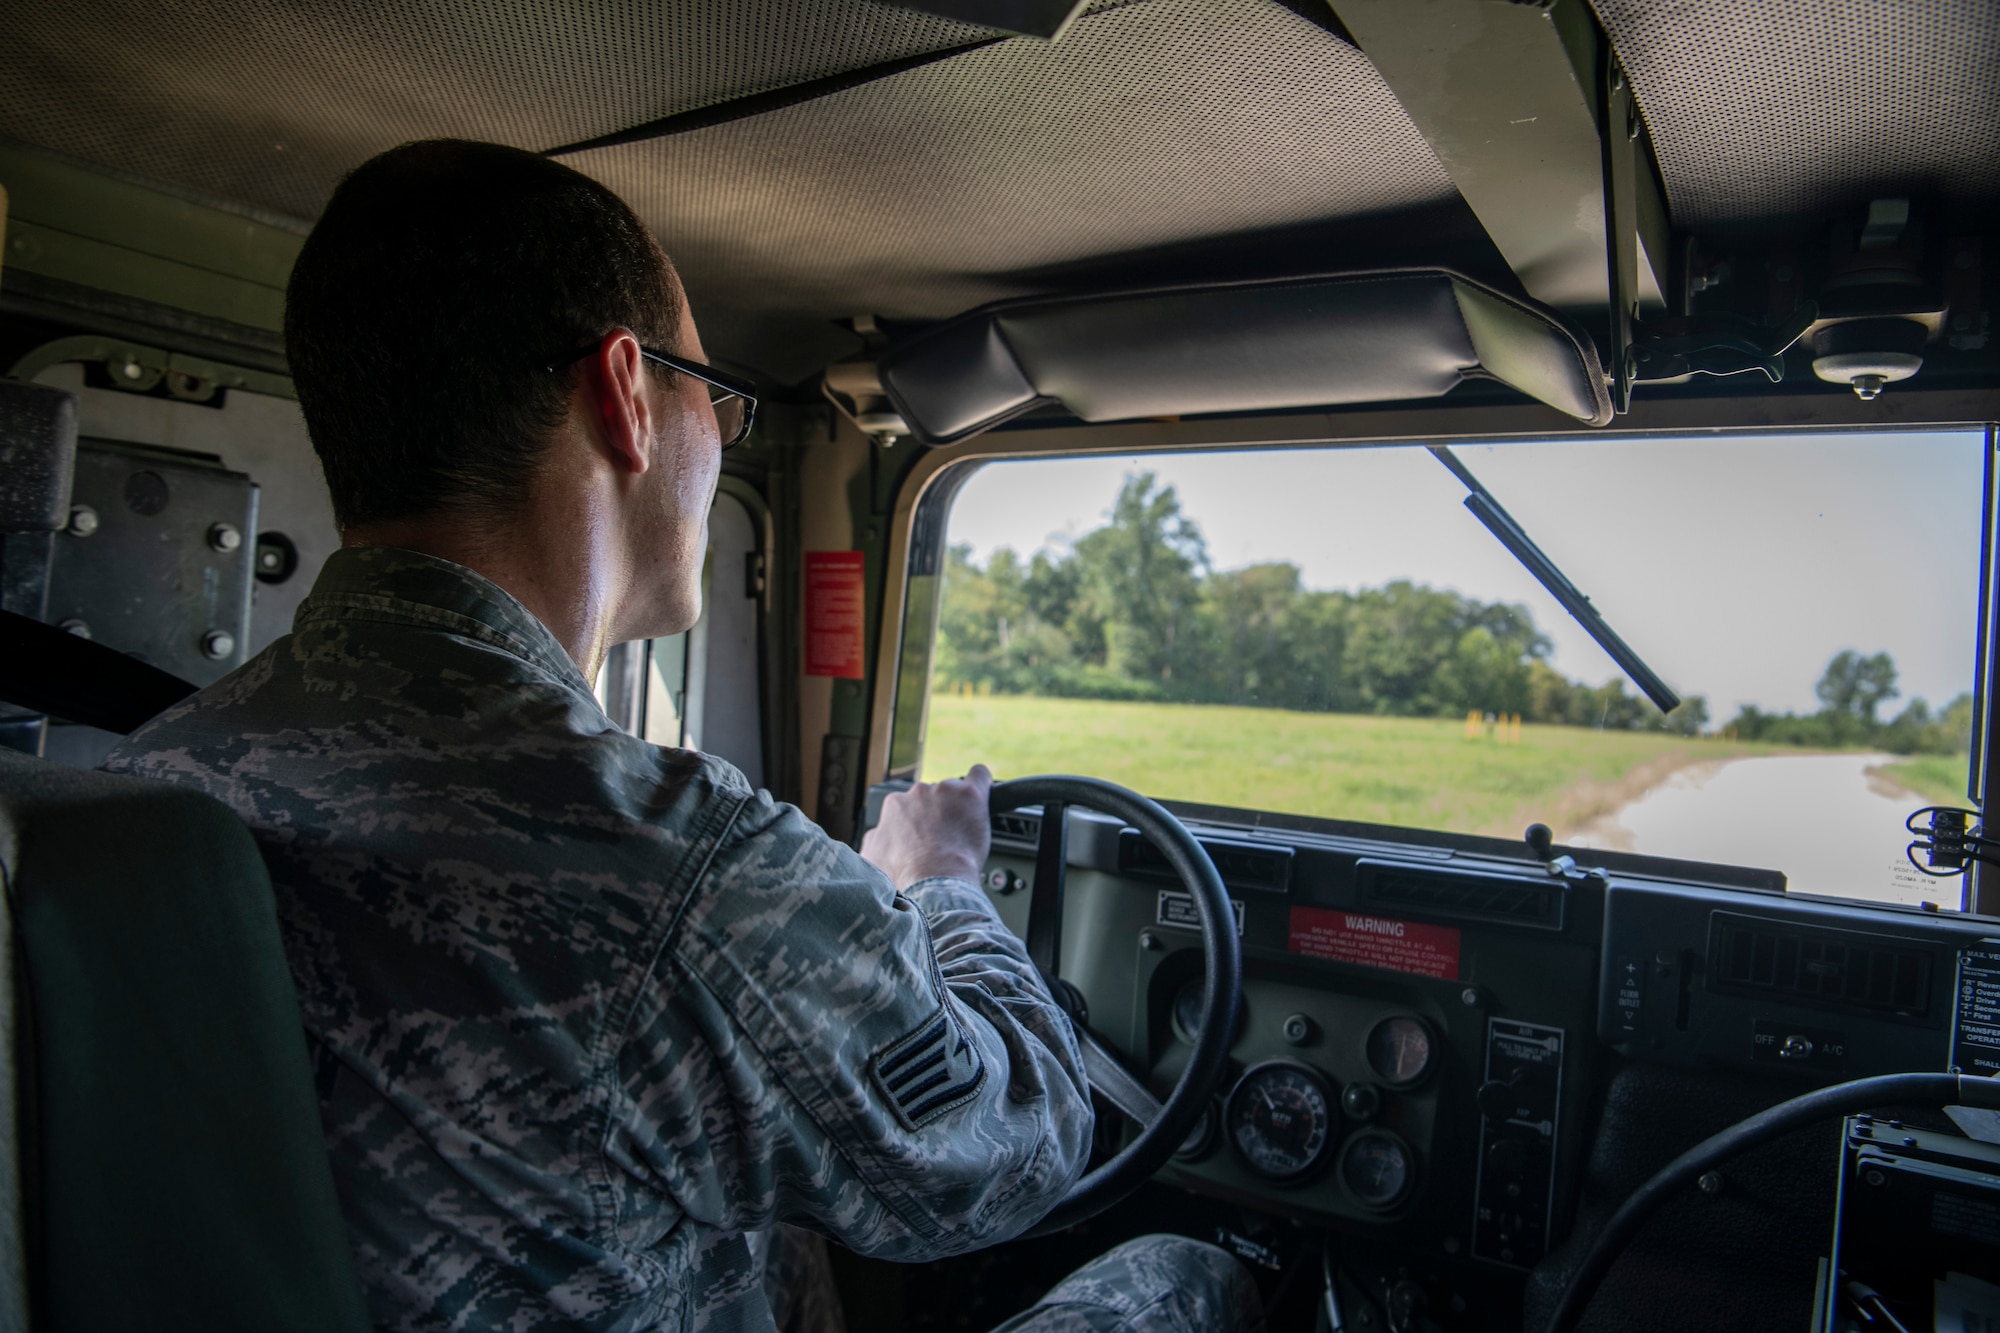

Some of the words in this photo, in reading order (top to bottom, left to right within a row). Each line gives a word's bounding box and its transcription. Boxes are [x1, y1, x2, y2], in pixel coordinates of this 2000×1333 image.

[1345, 915, 1404, 937] WARNING
[1323, 928, 1337, 936] NOT
[1353, 933, 1374, 942] HAND
[1376, 936, 1412, 947] THROTTLE
[1290, 932, 1328, 943] AUTOMATIC
[1329, 937, 1357, 947] VEHICLE
[1358, 942, 1381, 952] SPEED
[1394, 947, 1420, 958] CRUISE
[1300, 949, 1355, 963] AUTOMATICALLY
[1356, 957, 1377, 967] WHEN
[1377, 961, 1401, 971] BRAKE
[1313, 943, 1334, 952] HAND
[1334, 946, 1369, 957] THROTTLE
[1370, 952, 1387, 960] WILL
[1405, 957, 1446, 971] DISENGAGE
[1966, 950, 1987, 959] MAX.
[1620, 988, 1640, 998] FLOOR
[1618, 998, 1640, 1008] OUTLET
[1975, 996, 1997, 1006] Drive
[1973, 1012, 1992, 1021] First
[1518, 1027, 1533, 1037] AIR
[1754, 1034, 1776, 1045] OFF
[1821, 1044, 1844, 1056] A/C
[1271, 1111, 1292, 1124] MPH
